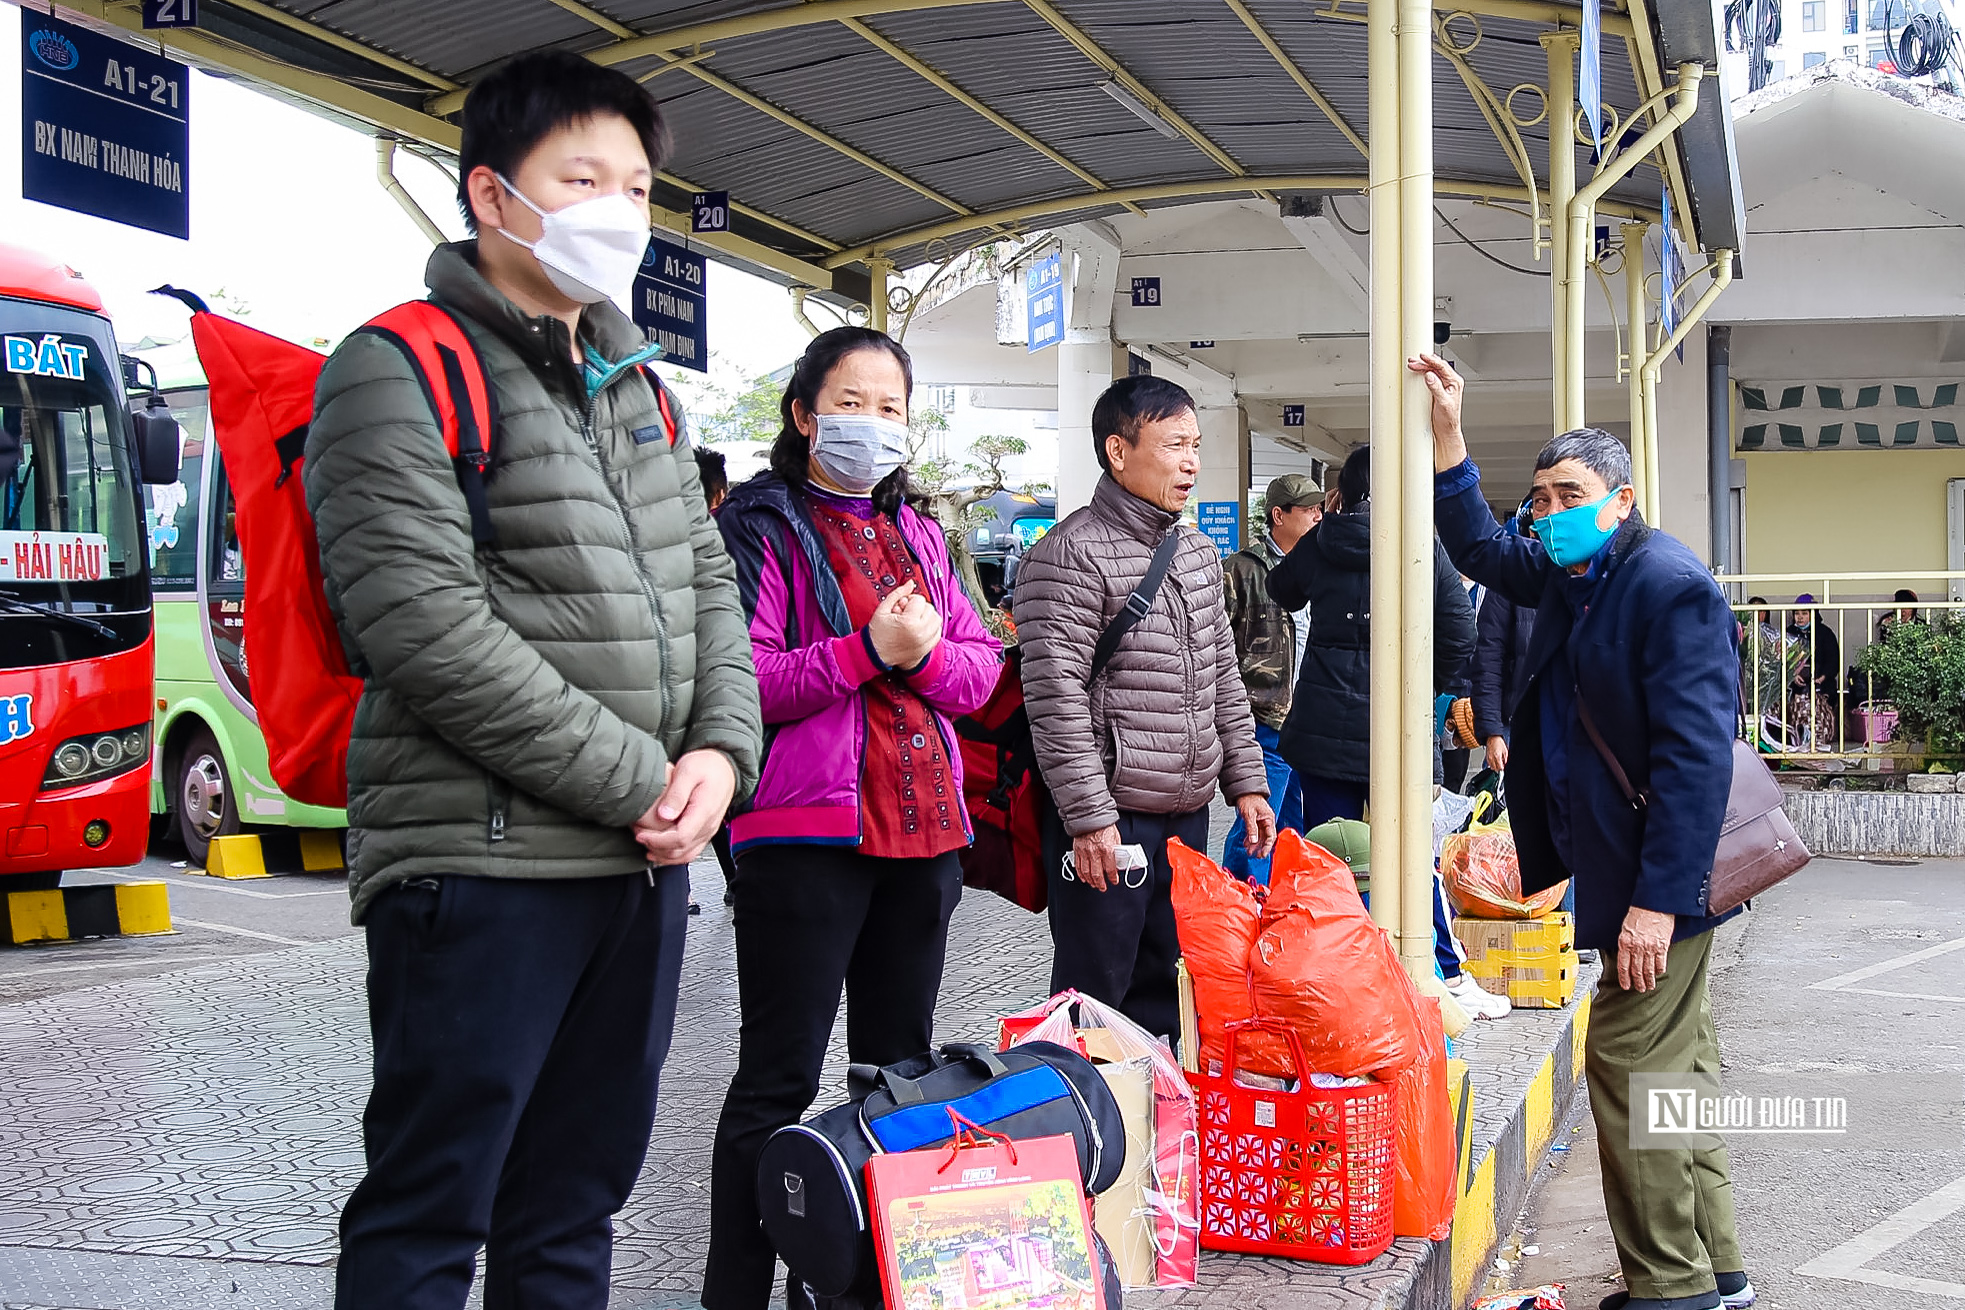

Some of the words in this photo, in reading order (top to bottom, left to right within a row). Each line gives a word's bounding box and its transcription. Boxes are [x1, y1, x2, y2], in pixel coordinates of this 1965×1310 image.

[104, 59, 179, 109] A1-21
[35, 120, 57, 158] BX
[61, 127, 98, 169] NAM
[102, 140, 150, 184] THANH
[153, 152, 182, 193] HÓA
[694, 195, 706, 205] A1
[698, 206, 724, 229] 20
[664, 255, 701, 285] A1-20
[1040, 262, 1060, 286] A1-19
[1133, 279, 1143, 287] A1
[646, 287, 657, 312] BX
[658, 290, 676, 318] PHÍA
[677, 298, 694, 323] NAM
[1137, 287, 1158, 303] 19
[5, 334, 88, 381] BÁT
[658, 329, 676, 355] NAM
[677, 334, 695, 362] ĐỊNH
[1287, 412, 1303, 424] 17
[15, 531, 52, 579] HẢI
